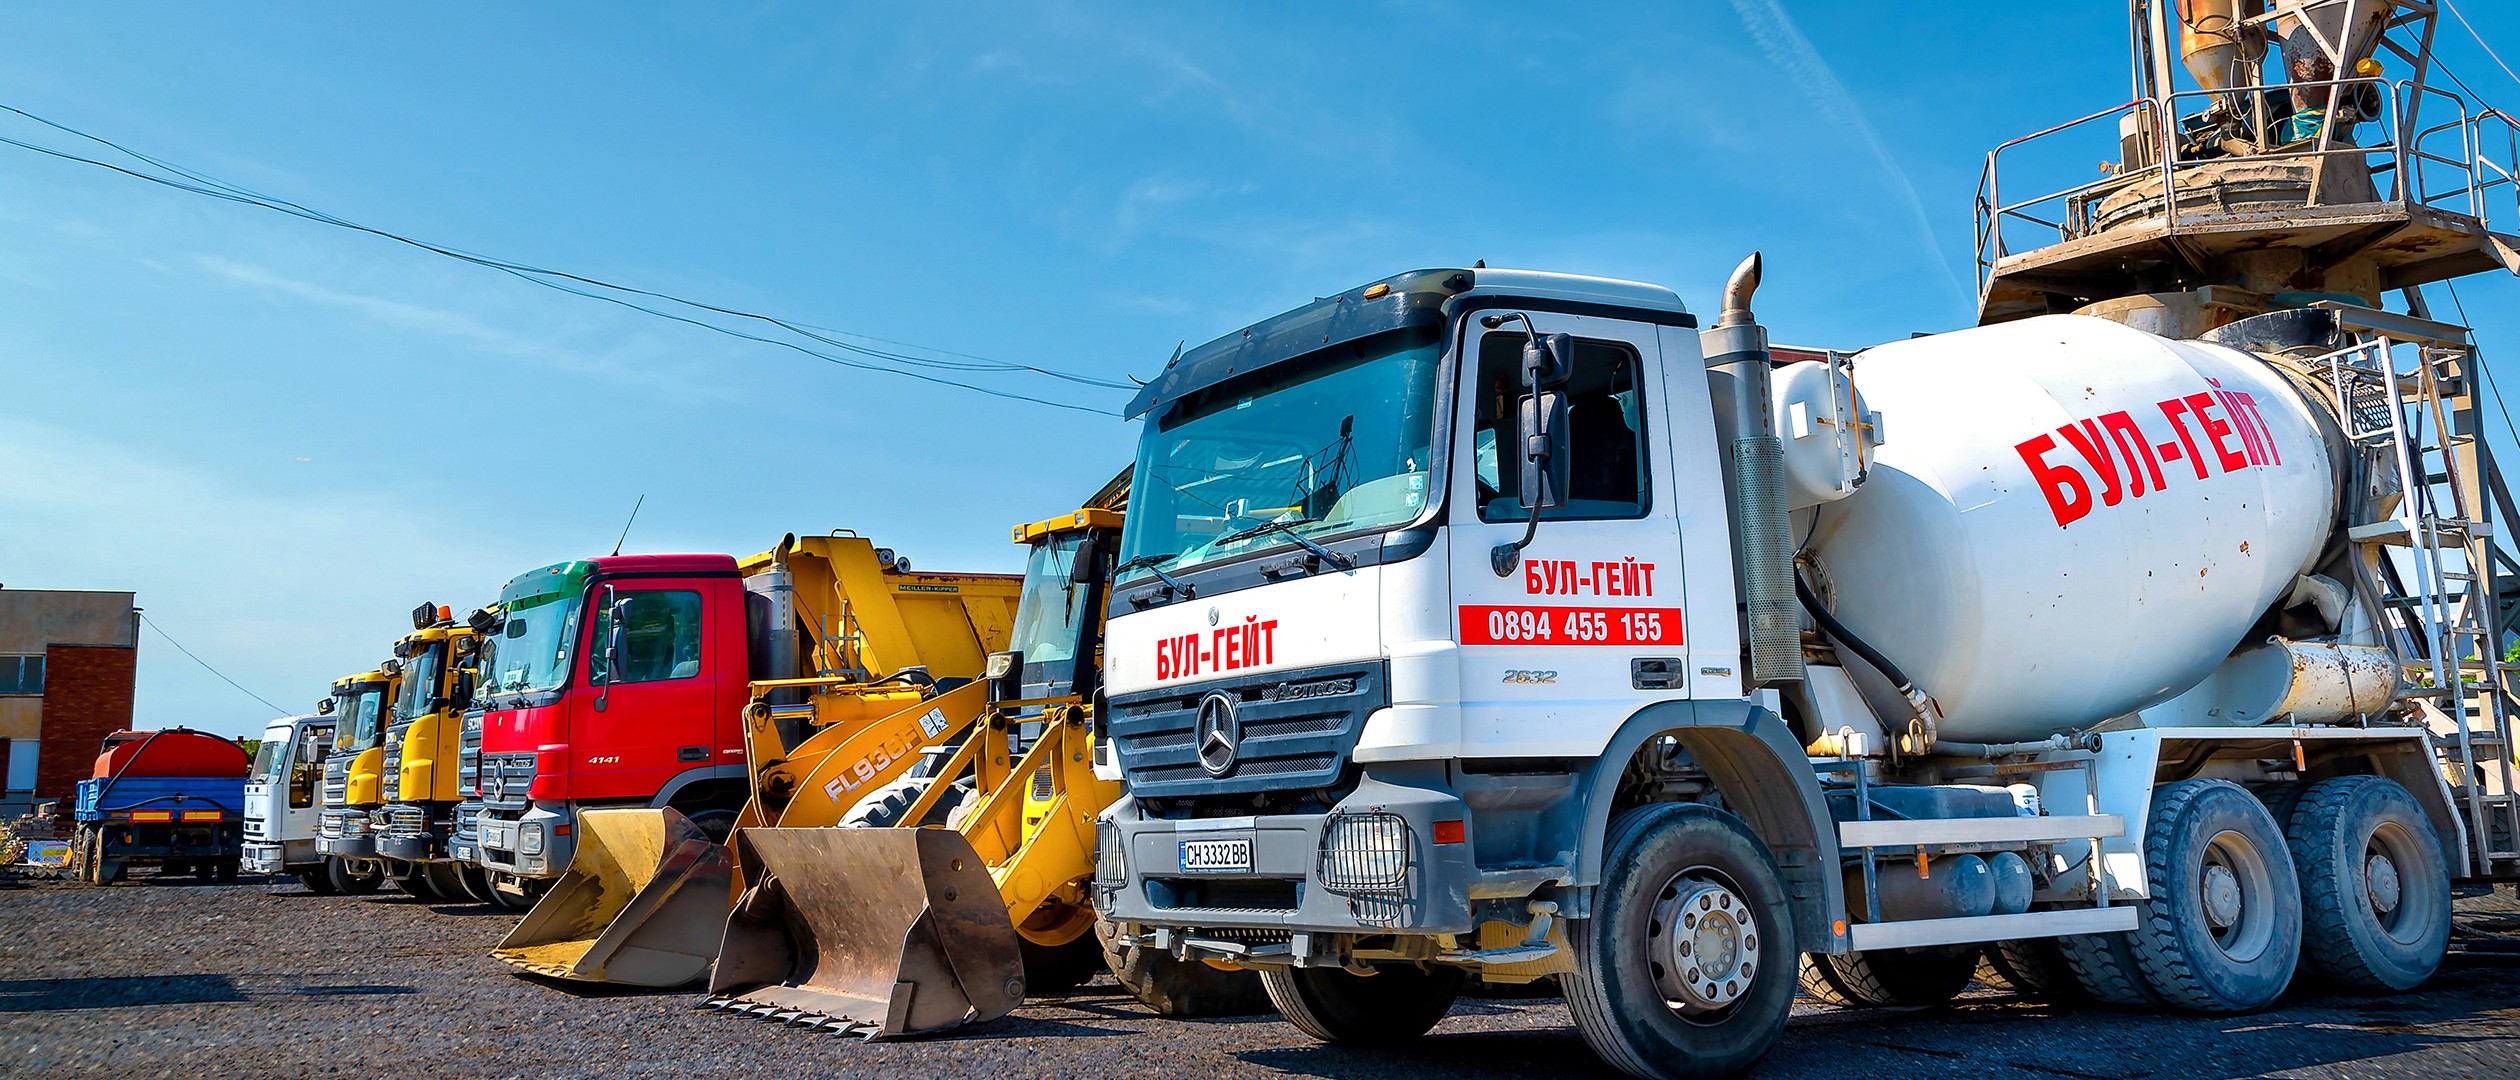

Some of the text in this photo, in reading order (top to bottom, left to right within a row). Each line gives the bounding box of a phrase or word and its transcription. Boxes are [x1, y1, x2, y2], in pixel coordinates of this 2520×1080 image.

[2014, 376, 2282, 528] БУЛ-ГЕЙТ
[899, 584, 958, 592] MEILLER-KIPPER
[1524, 556, 1655, 597] БУЛ-ГЕЙТ
[1488, 610, 1662, 642] 0894 455 155
[1157, 614, 1278, 681] БУЛ-ГЕЙТ
[1502, 669, 1558, 685] 2632
[588, 756, 620, 764] 4141
[823, 722, 923, 805] FL936F
